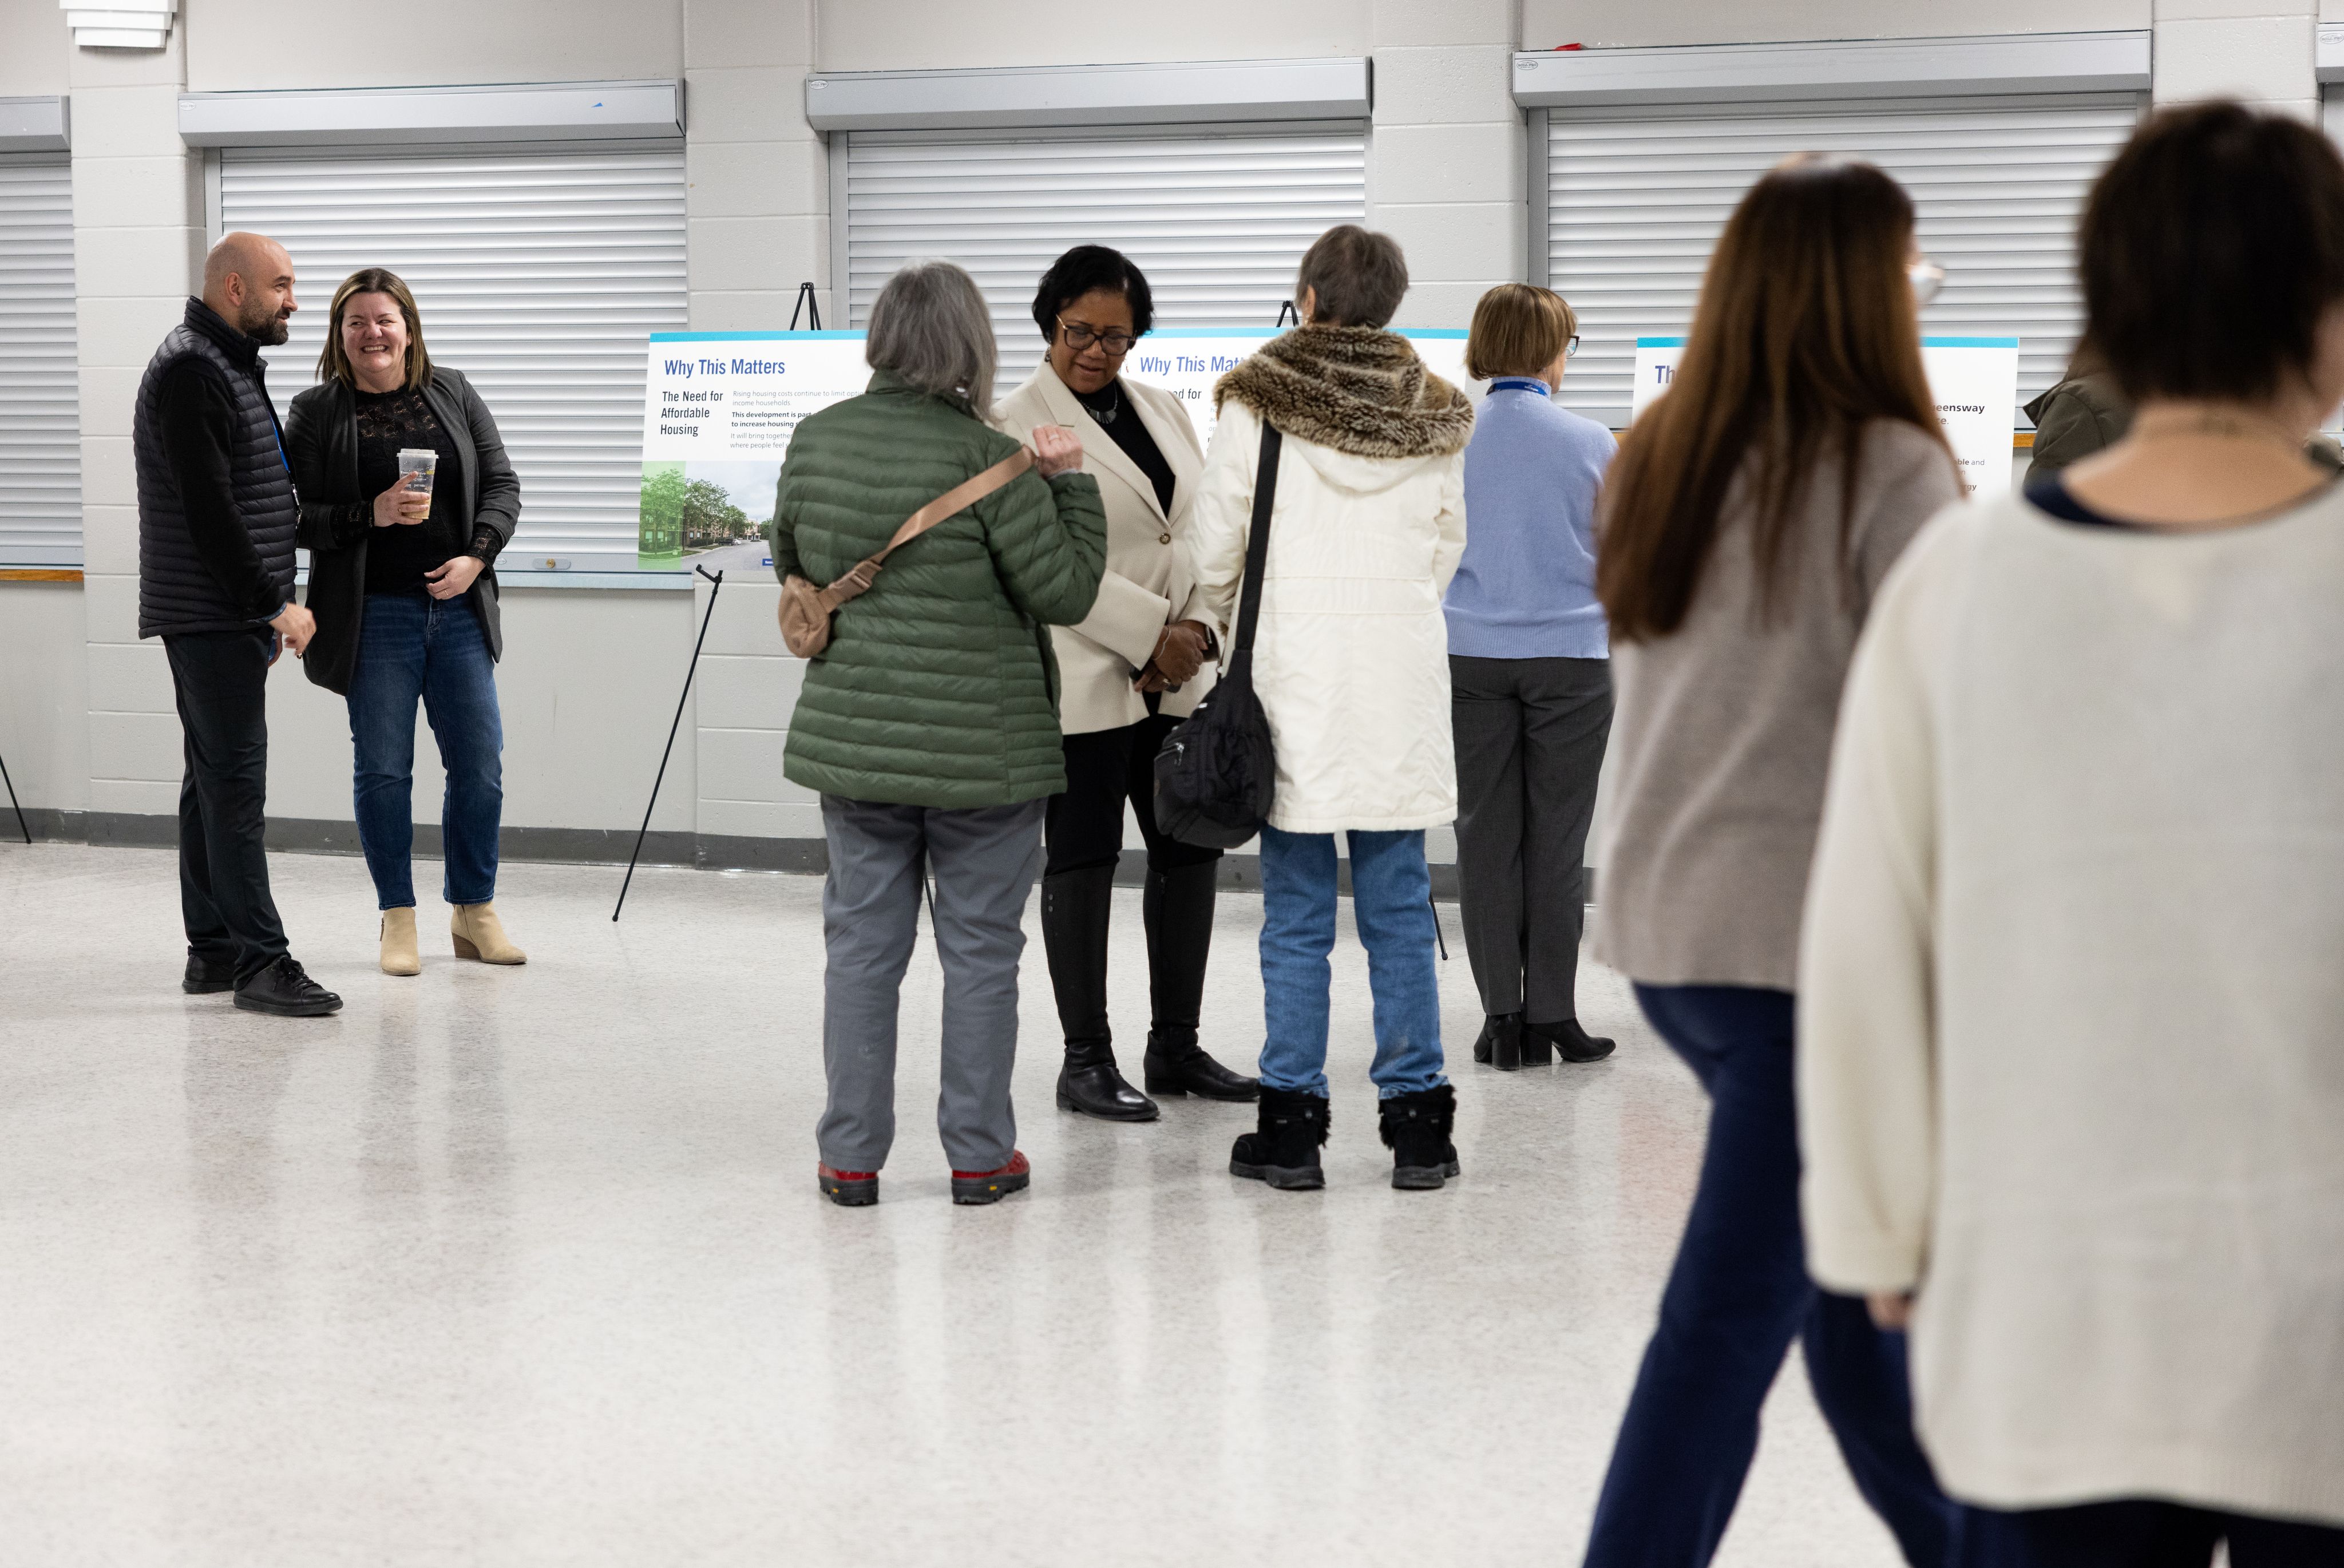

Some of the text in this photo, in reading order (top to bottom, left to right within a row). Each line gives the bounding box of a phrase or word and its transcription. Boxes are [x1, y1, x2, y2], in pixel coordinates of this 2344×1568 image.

[664, 358, 786, 379] Why This Matters
[1140, 357, 1171, 377] Why
[1176, 355, 1206, 372] This
[662, 390, 723, 402] The Need for
[733, 390, 751, 398] Rising
[753, 390, 777, 398] housing
[1187, 388, 1202, 399] for
[661, 407, 710, 418] Affordable
[746, 411, 789, 419] development
[660, 423, 699, 437] Housing
